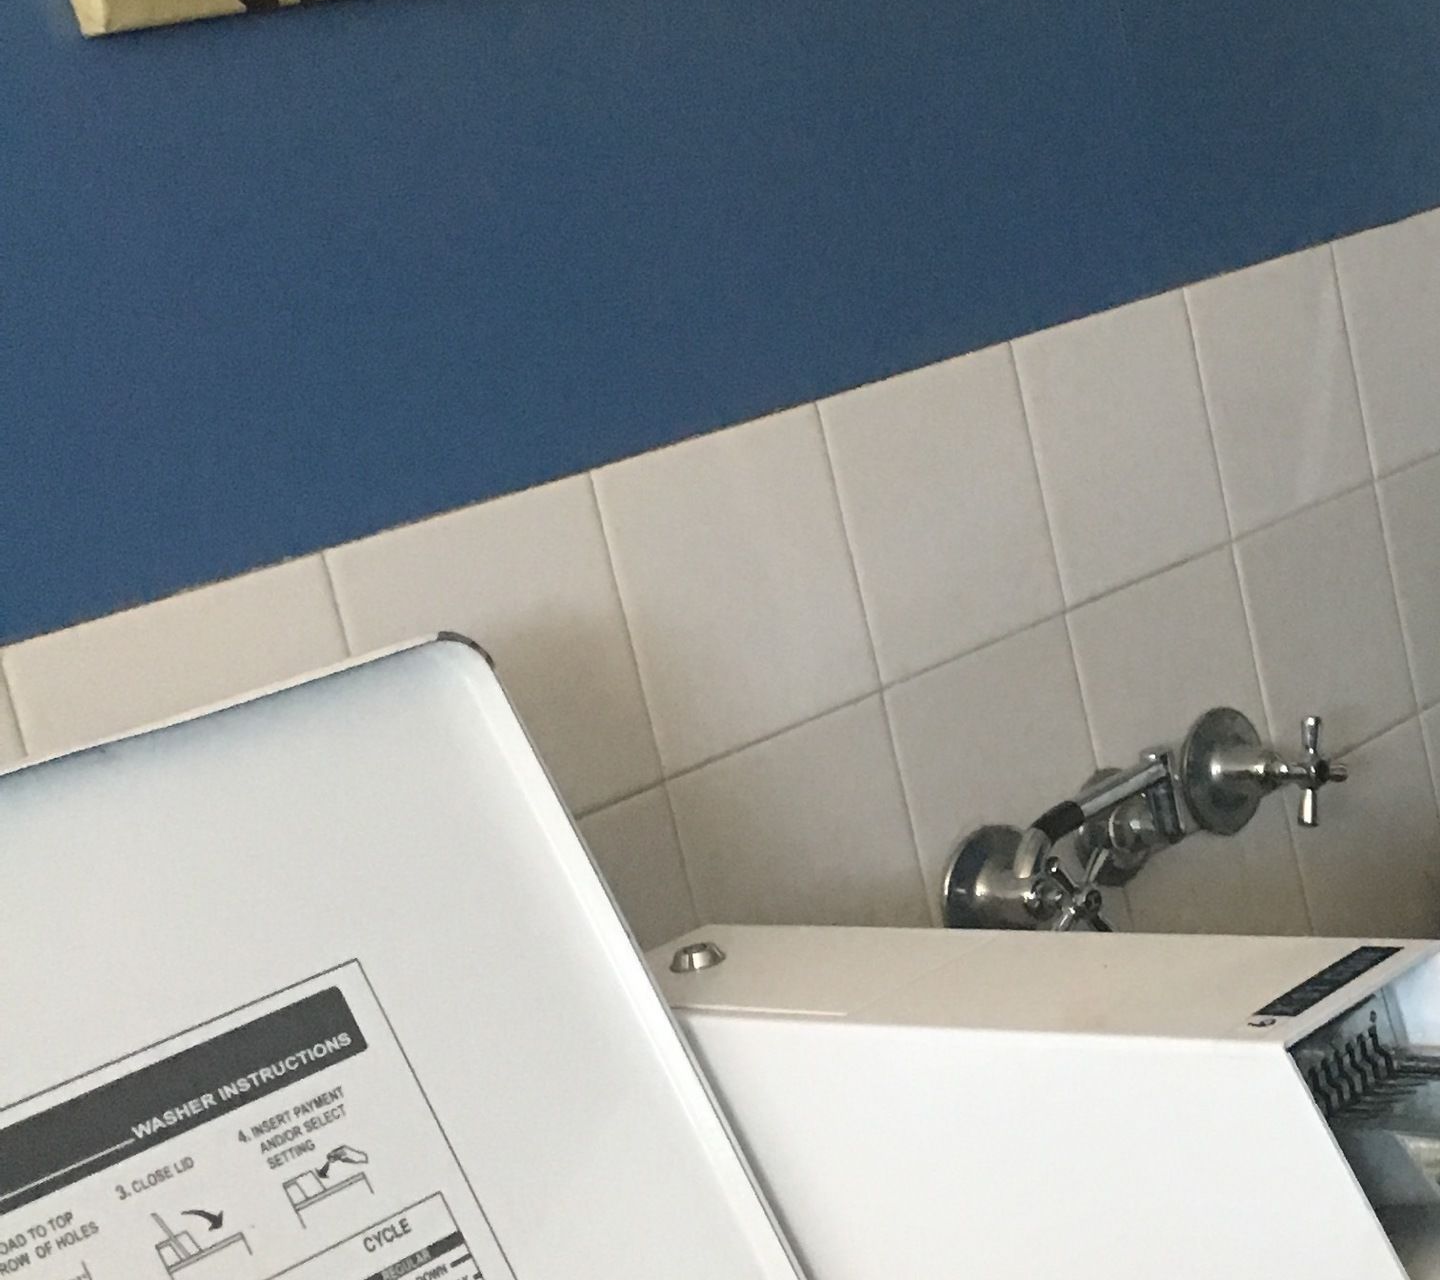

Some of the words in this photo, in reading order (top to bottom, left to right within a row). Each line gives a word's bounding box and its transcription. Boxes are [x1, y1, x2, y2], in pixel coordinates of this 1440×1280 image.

[130, 1091, 217, 1140] WASHER
[216, 1030, 353, 1102] INSTRUCTIONS
[234, 1127, 252, 1145] 4.
[249, 1108, 294, 1138] INSERT
[290, 1084, 346, 1119] PAYMENT
[301, 1103, 348, 1134] SELECT
[265, 1137, 317, 1170] SETTING
[113, 1181, 132, 1202] 3.
[129, 1164, 174, 1194] CLOSE
[171, 1154, 196, 1175] LID
[0, 1231, 28, 1256] OAD
[25, 1222, 49, 1242] TO
[45, 1209, 76, 1233] TOP
[33, 1240, 55, 1260] OF
[53, 1219, 101, 1251] HOLES
[360, 1216, 413, 1255] CYCLE
